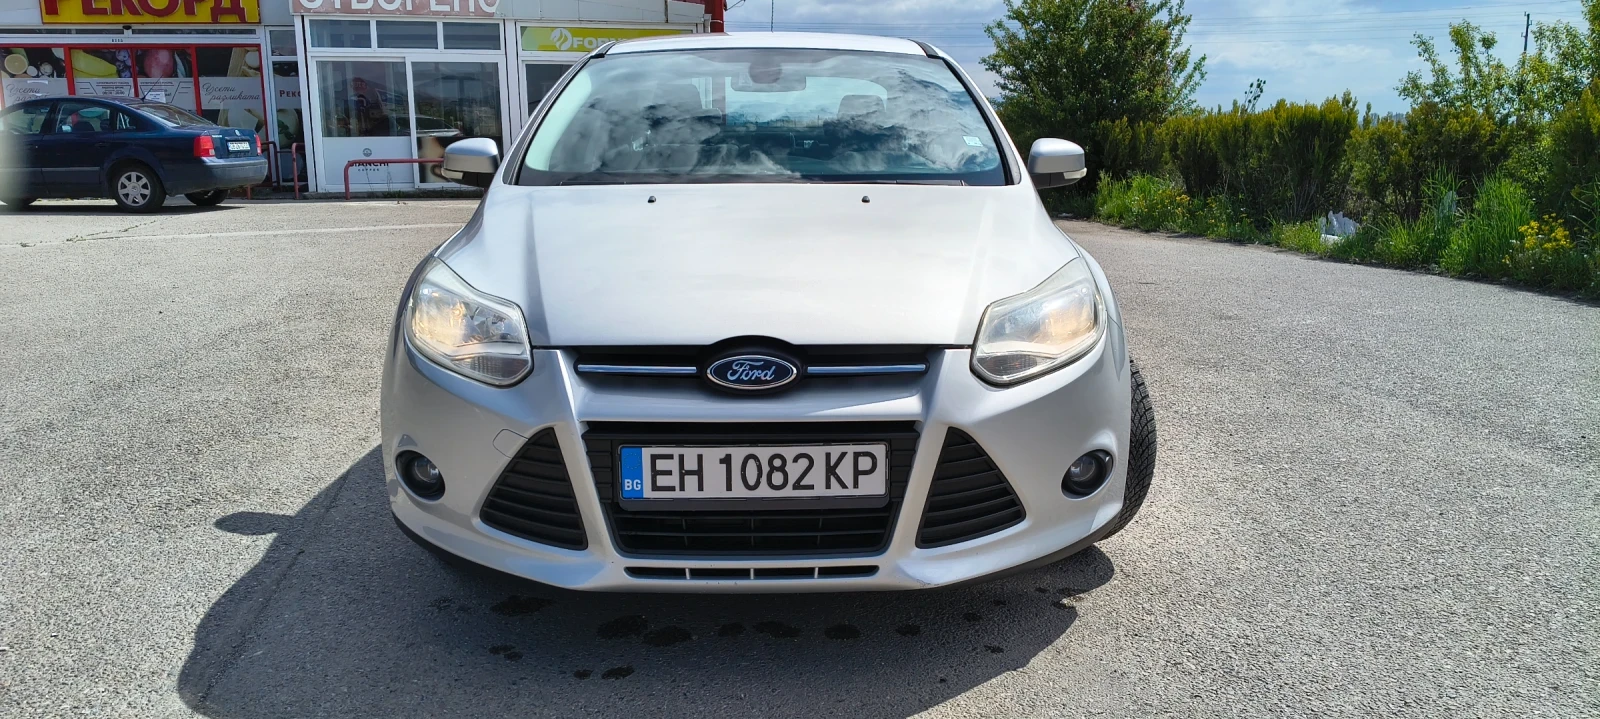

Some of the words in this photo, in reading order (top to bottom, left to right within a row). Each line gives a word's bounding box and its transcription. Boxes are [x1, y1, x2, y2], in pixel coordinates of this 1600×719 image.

[202, 82, 236, 96] Усети
[208, 91, 261, 104] разликата
[727, 360, 776, 380] Ford
[650, 453, 704, 492] EH
[719, 453, 815, 491] 1082
[825, 451, 878, 490] KP
[624, 479, 642, 491] BG
